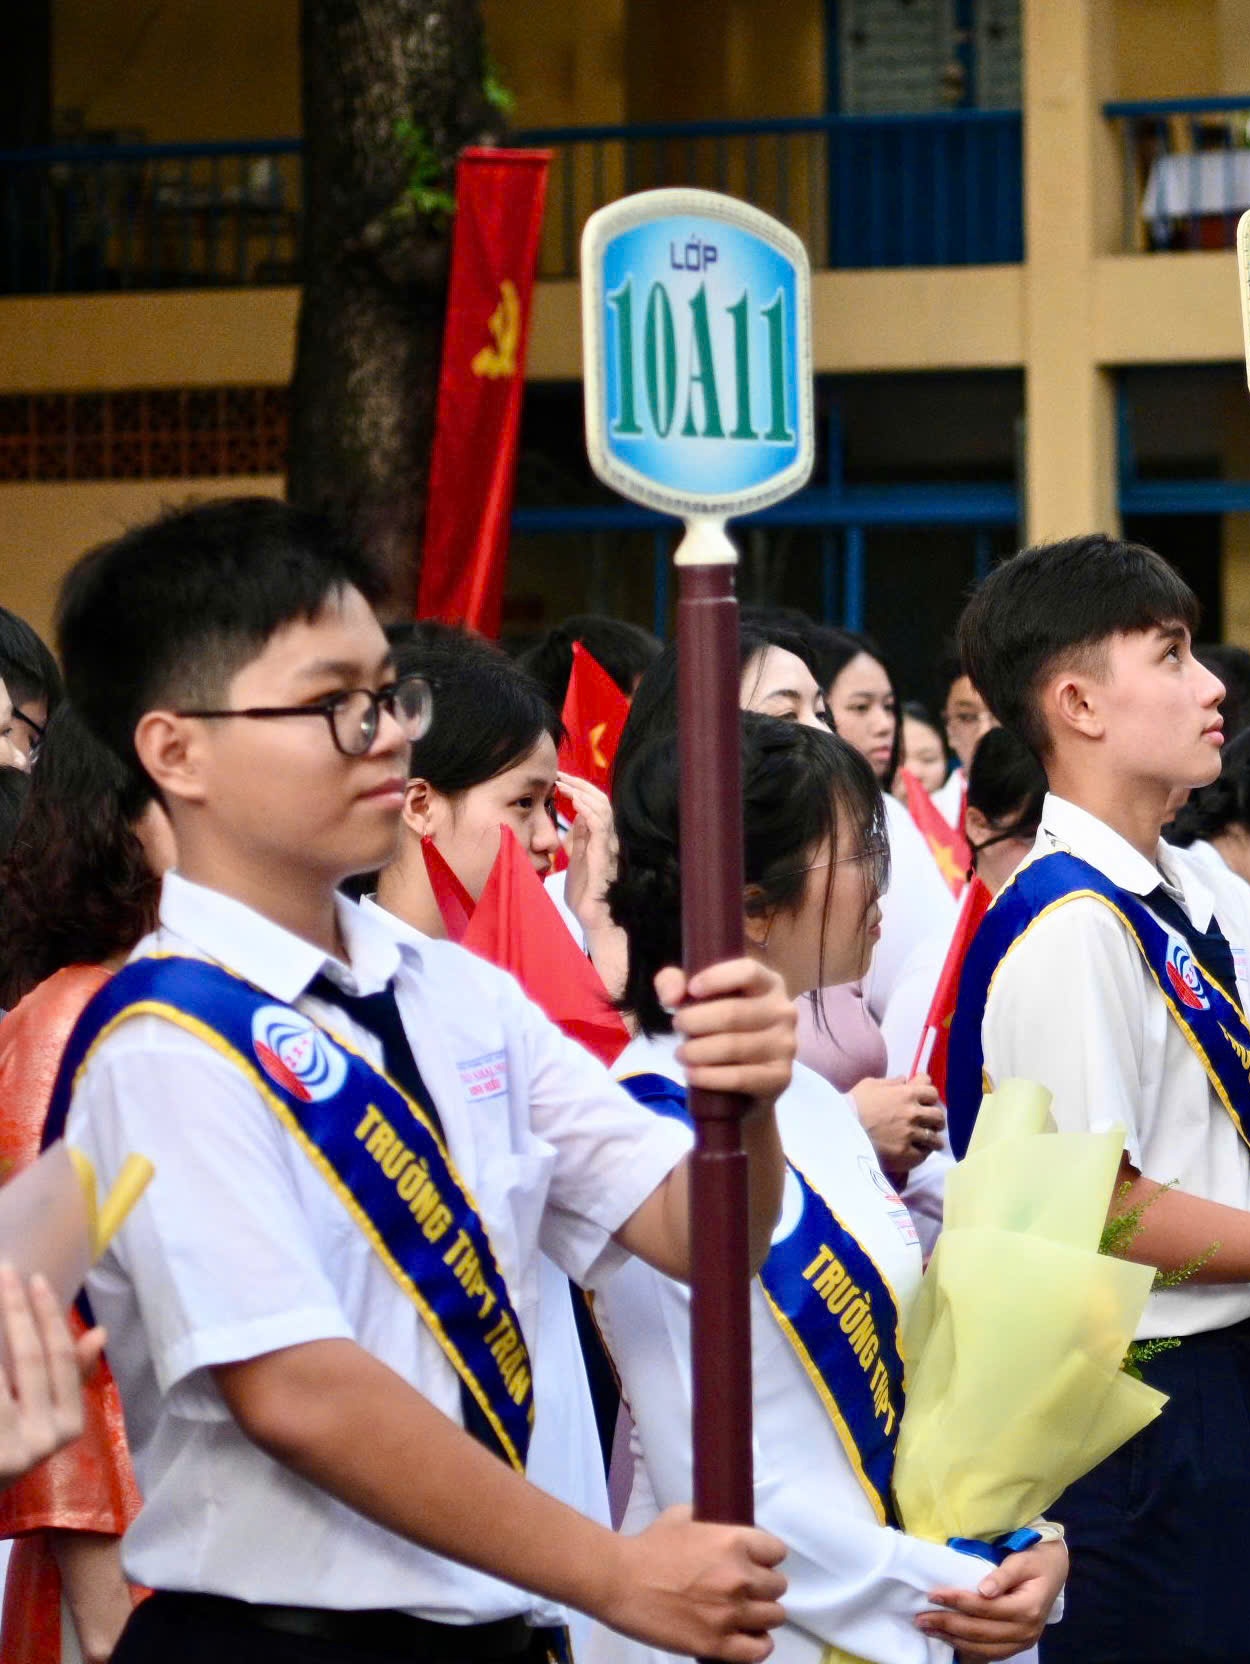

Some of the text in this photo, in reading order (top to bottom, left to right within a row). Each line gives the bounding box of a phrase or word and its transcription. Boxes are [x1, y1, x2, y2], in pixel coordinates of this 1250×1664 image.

[670, 233, 718, 272] LỚP
[606, 276, 794, 442] 10A11
[353, 1103, 453, 1245] TRƯỜNG
[443, 1228, 497, 1321] THPT
[802, 1243, 897, 1437] TRƯỜNG THPT
